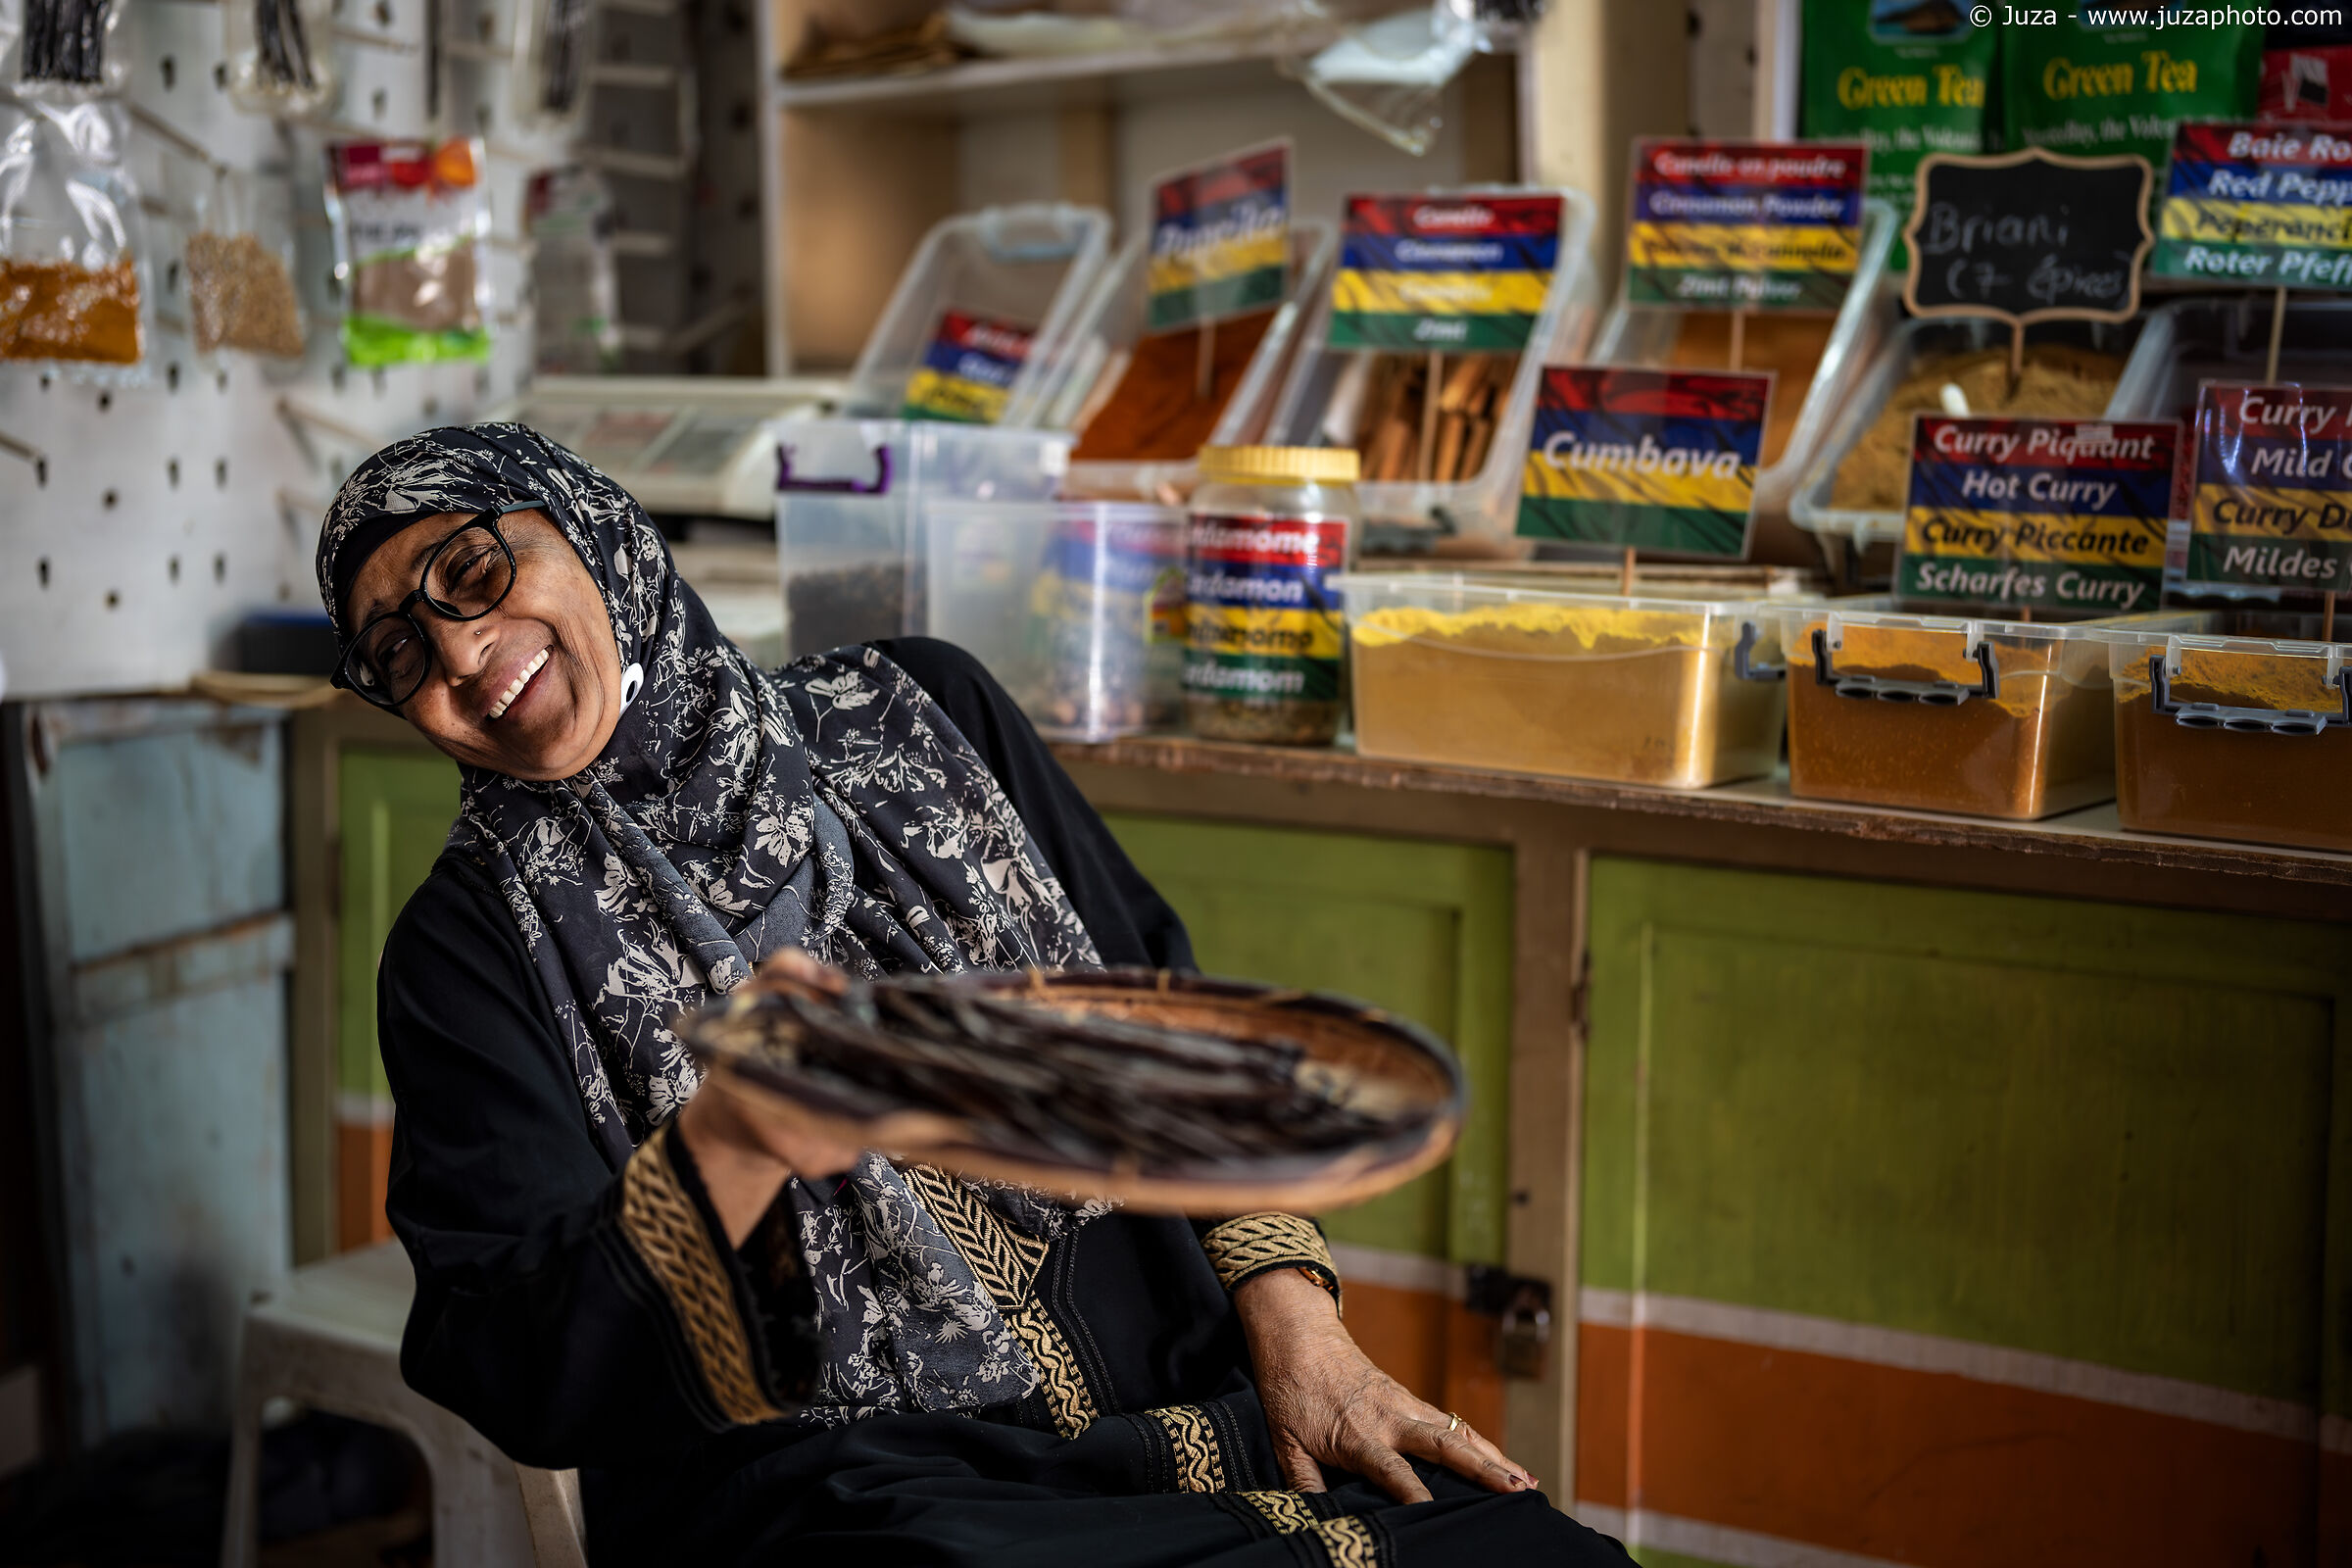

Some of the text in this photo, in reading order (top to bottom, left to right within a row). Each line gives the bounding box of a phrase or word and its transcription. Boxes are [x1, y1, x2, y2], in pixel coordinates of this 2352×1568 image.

[1837, 64, 1986, 111] Green Tea
[2043, 49, 2198, 101] Green Tea
[2227, 129, 2352, 163] Baie Ro
[1765, 154, 1847, 180] poudre
[2207, 169, 2273, 198] Red
[1923, 201, 2071, 255] Briani
[2183, 245, 2273, 276] Roter
[2238, 395, 2337, 436] Curry
[1543, 429, 1742, 480] Cumbava
[1933, 423, 2156, 466] Curry Piquant
[2250, 446, 2334, 480] Mild
[1962, 468, 2117, 512] Hot Curry
[1922, 515, 2150, 555] Curry Piccante
[2213, 498, 2352, 536] Curry D
[2223, 545, 2338, 580] Mildes
[1915, 560, 2146, 611] Scharfes Curry
